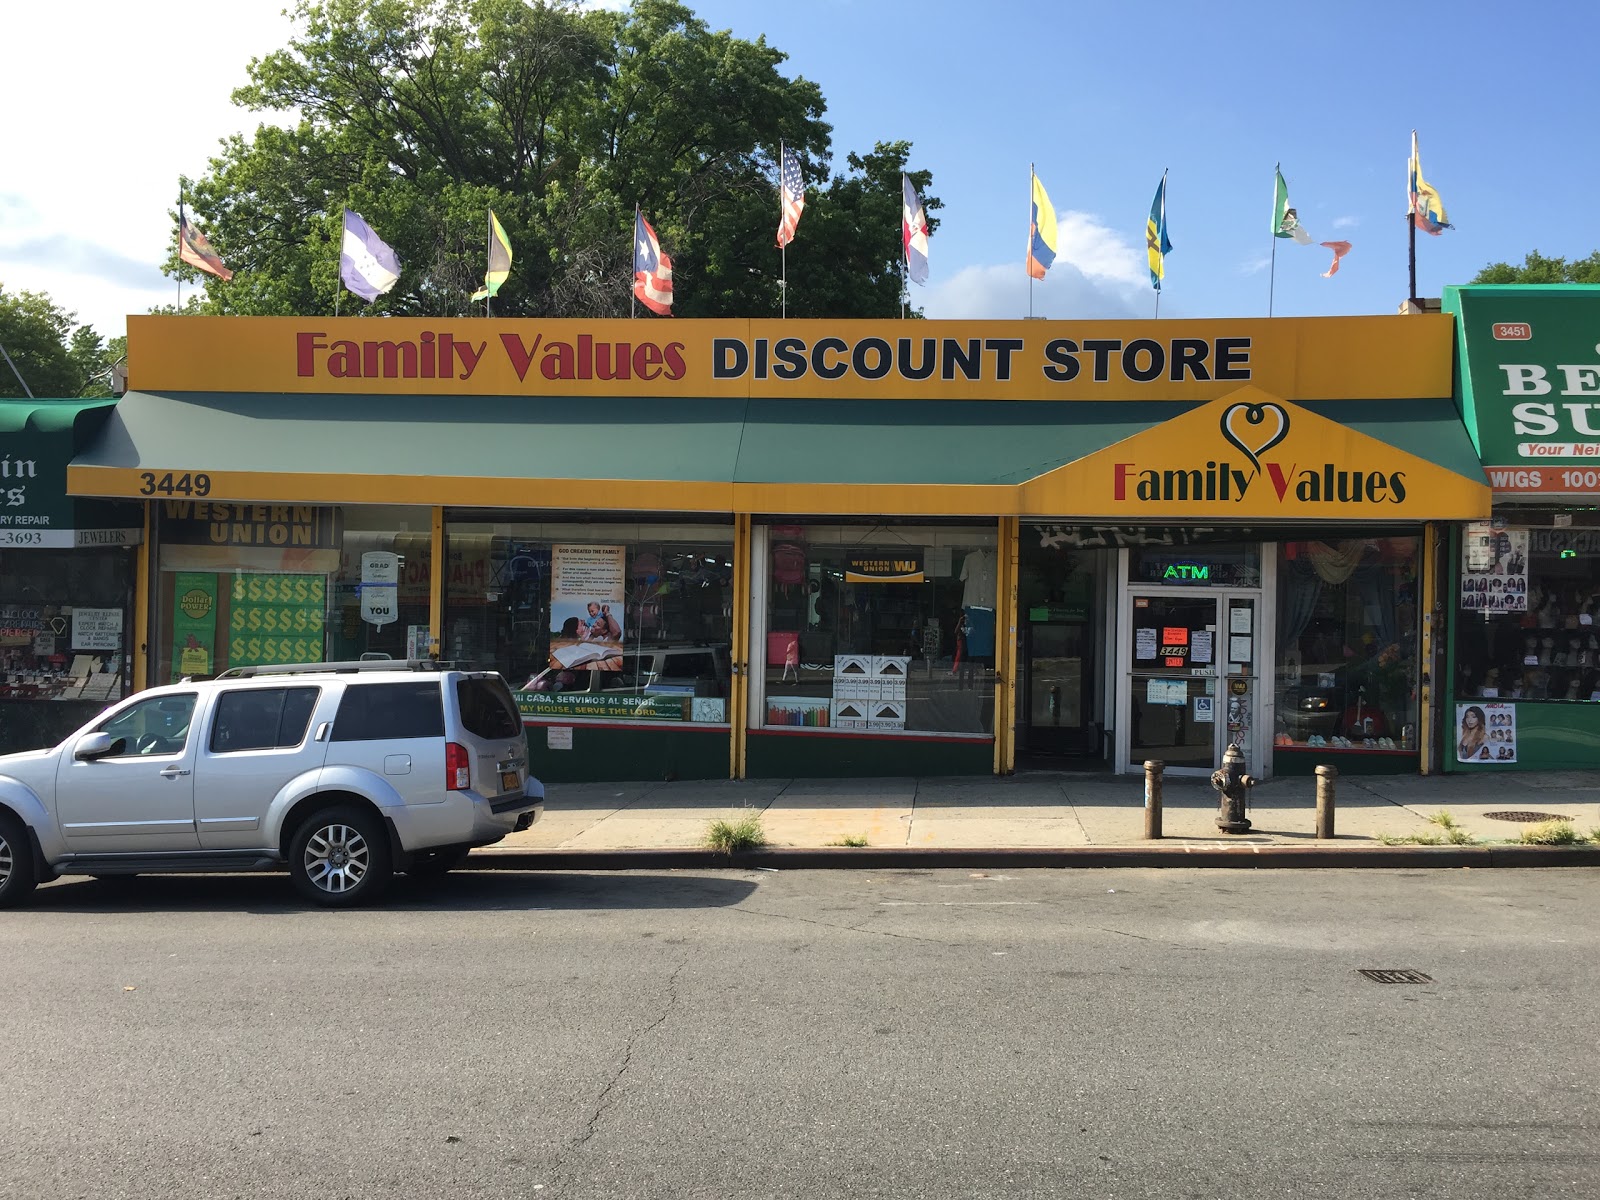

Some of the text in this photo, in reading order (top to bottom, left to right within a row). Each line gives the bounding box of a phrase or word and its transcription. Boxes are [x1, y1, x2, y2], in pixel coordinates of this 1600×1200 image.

[1500, 327, 1525, 336] 3451
[296, 331, 1252, 383] Family Values DISCOUNT STORE
[1528, 444, 1565, 456] Your
[139, 472, 211, 496] 3449
[1114, 461, 1407, 503] Family Values
[1490, 471, 1542, 487] WIGS
[165, 500, 312, 523] WESTERN
[15, 515, 50, 525] REPAIR
[79, 531, 126, 544] JEWELERS
[210, 523, 312, 545] UNION
[893, 560, 917, 572] WU
[1163, 565, 1209, 580] ATM
[182, 595, 208, 604] Dollar
[370, 607, 390, 615] YOU
[1161, 647, 1187, 656] 3449
[1166, 657, 1183, 666] ENTER
[557, 696, 605, 705] SERVIMOS
[630, 708, 656, 716] LORD
